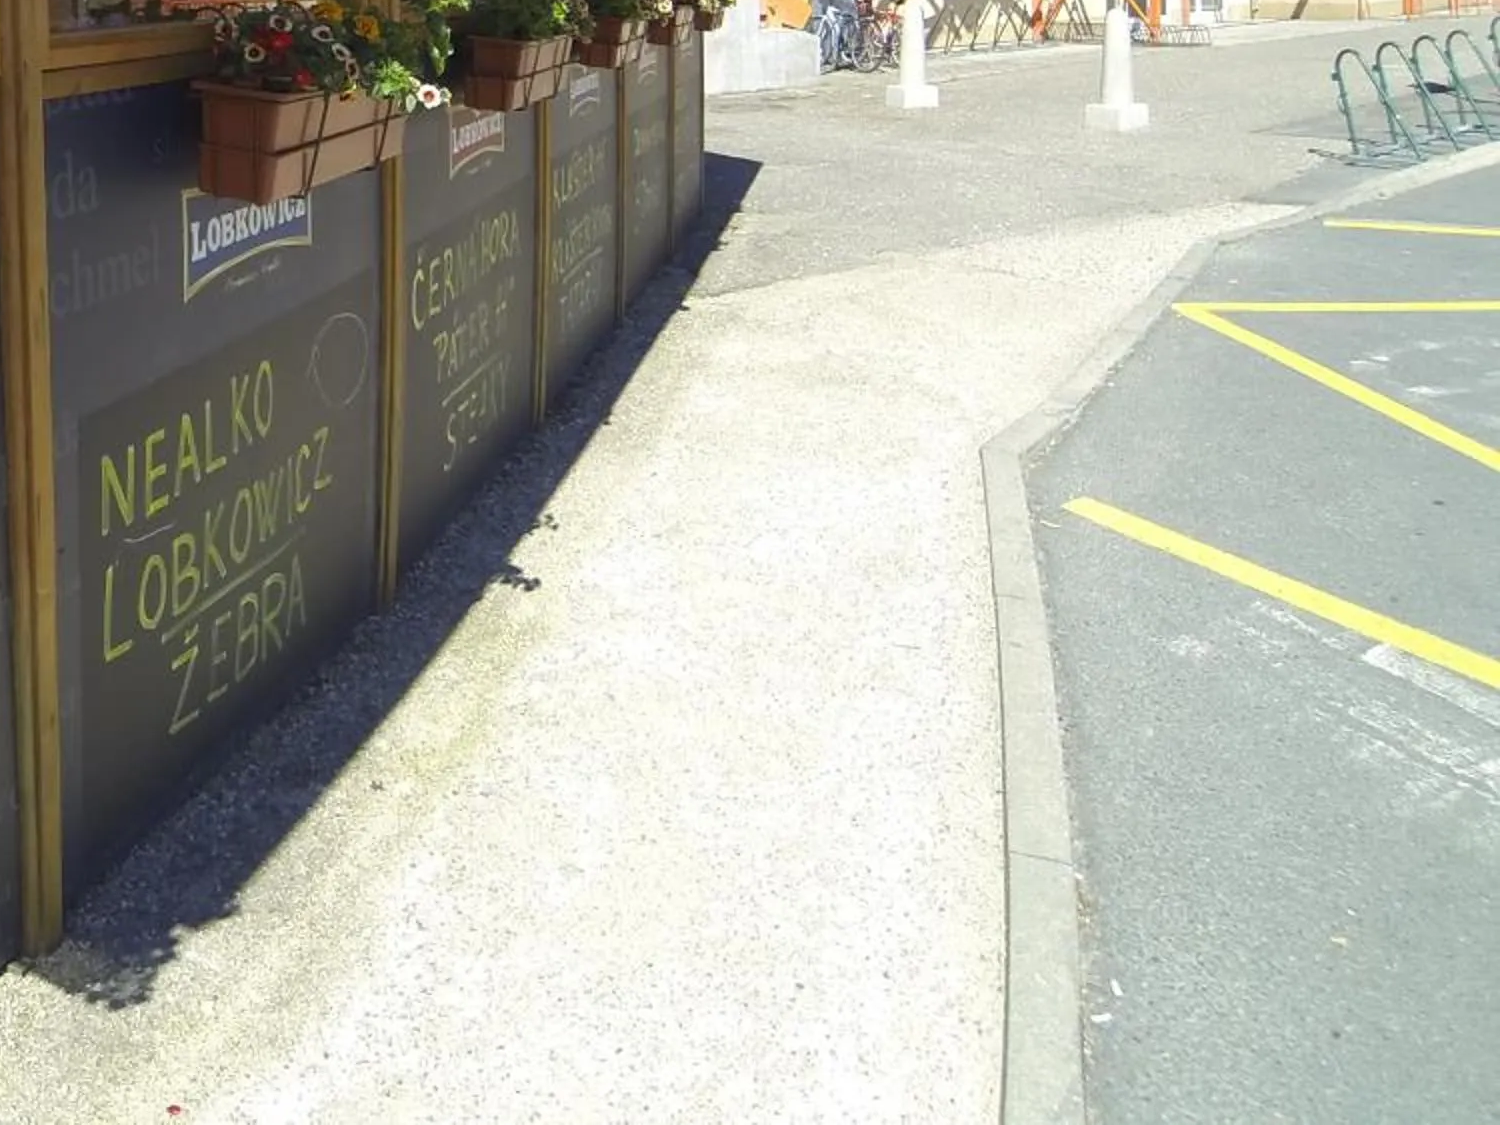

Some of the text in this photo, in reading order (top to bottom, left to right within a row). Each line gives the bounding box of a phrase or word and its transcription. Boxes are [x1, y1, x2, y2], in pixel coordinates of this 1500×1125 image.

[49, 221, 161, 317] chmel
[100, 359, 275, 536] NEALKO
[102, 425, 333, 662] LOBKOWICZ
[168, 553, 308, 735] ŽEBRA
